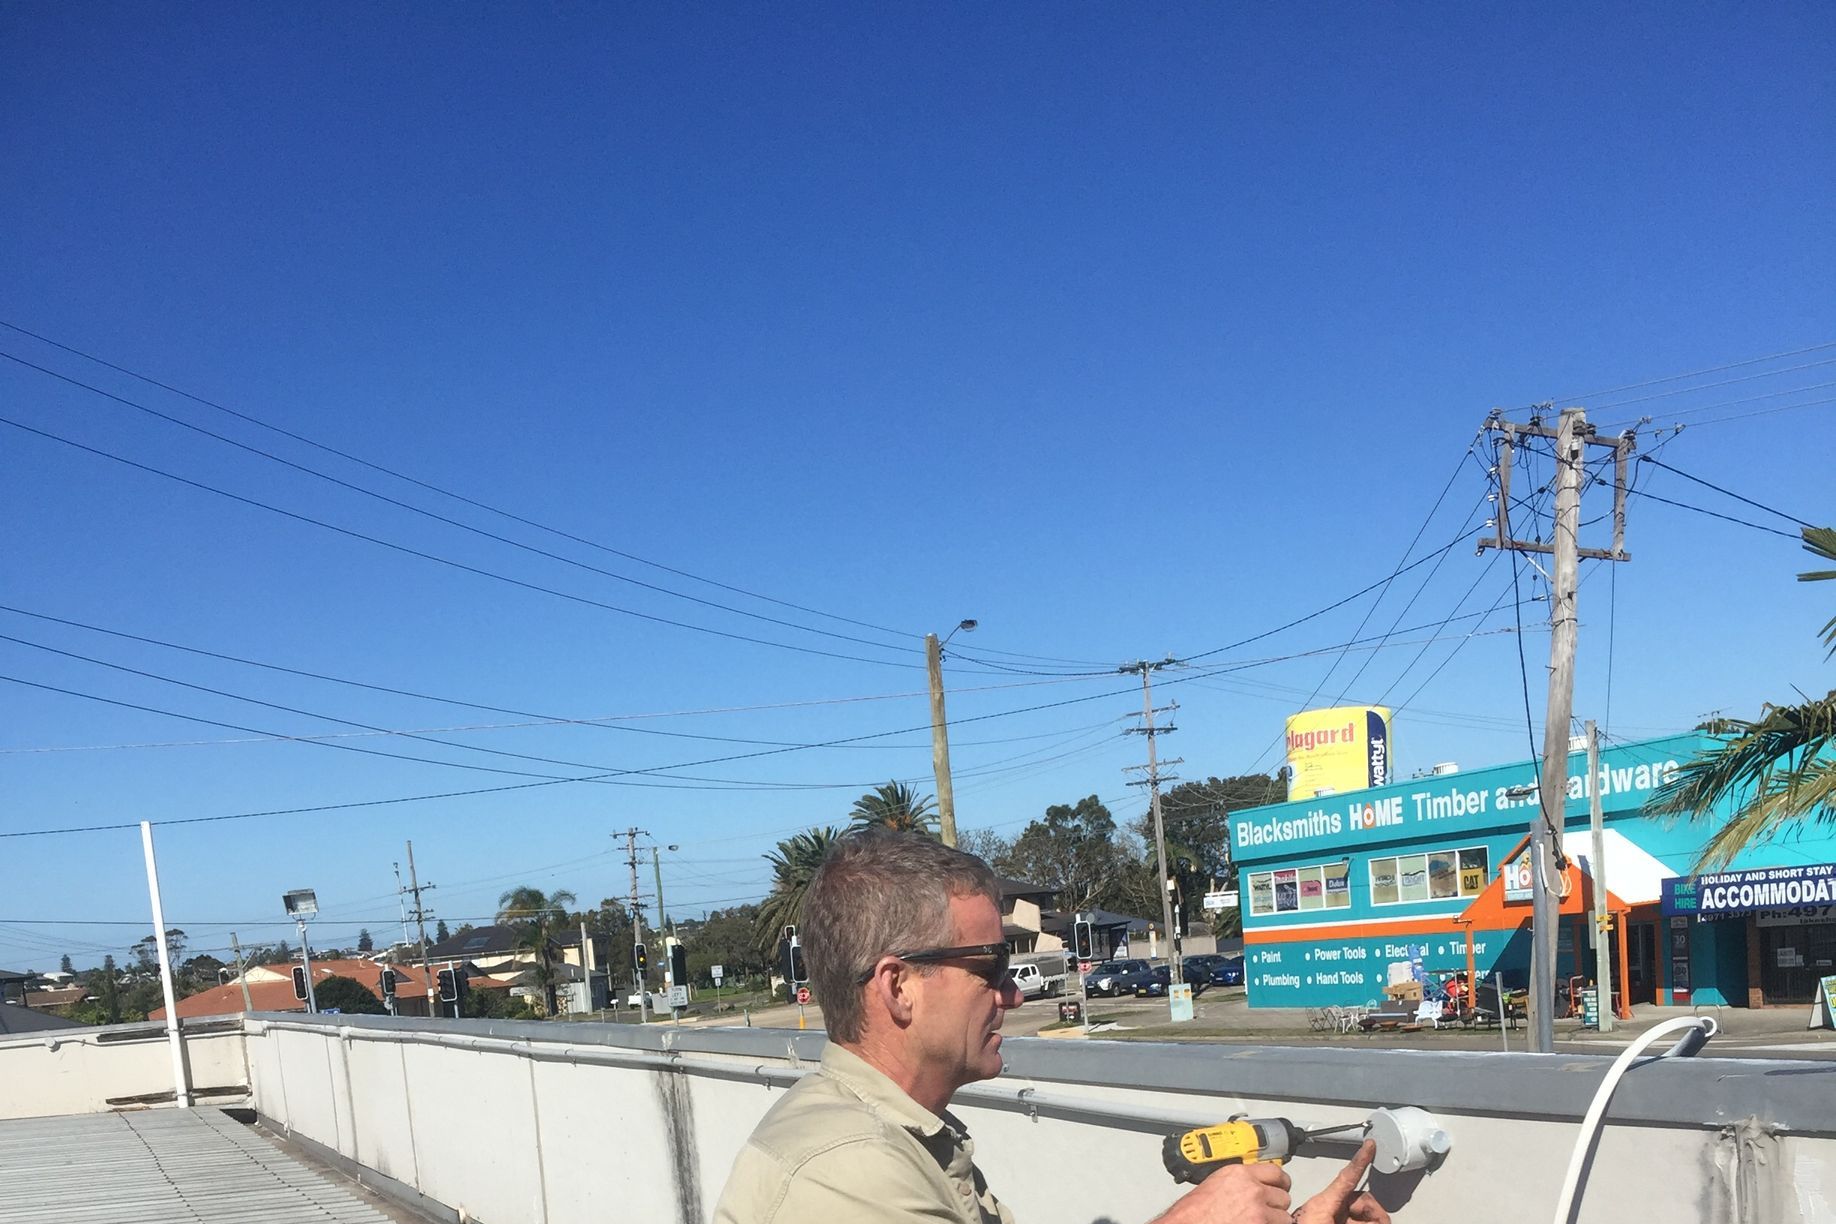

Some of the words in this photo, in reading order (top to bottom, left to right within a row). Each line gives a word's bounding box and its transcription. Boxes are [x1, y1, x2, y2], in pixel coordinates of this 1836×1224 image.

[1237, 810, 1342, 847] Blacksmiths
[1349, 796, 1404, 831] HOME
[1411, 787, 1488, 821] Timber
[1565, 759, 1681, 800] ardware
[1463, 875, 1479, 890] CAT
[1701, 873, 1743, 885] HOLIDAY
[1745, 871, 1766, 881] AND
[1768, 868, 1804, 879] SHORT
[1806, 865, 1833, 876] STAY
[1674, 883, 1697, 895] BIKE
[1674, 897, 1697, 909] HIRE
[1261, 951, 1281, 963] Paint
[1314, 948, 1341, 960] Power
[1342, 946, 1367, 959] Tools
[1385, 942, 1429, 958] Electal
[1262, 973, 1300, 989] Plumbing
[1316, 972, 1339, 985] Hand
[1340, 970, 1364, 984] Tools
